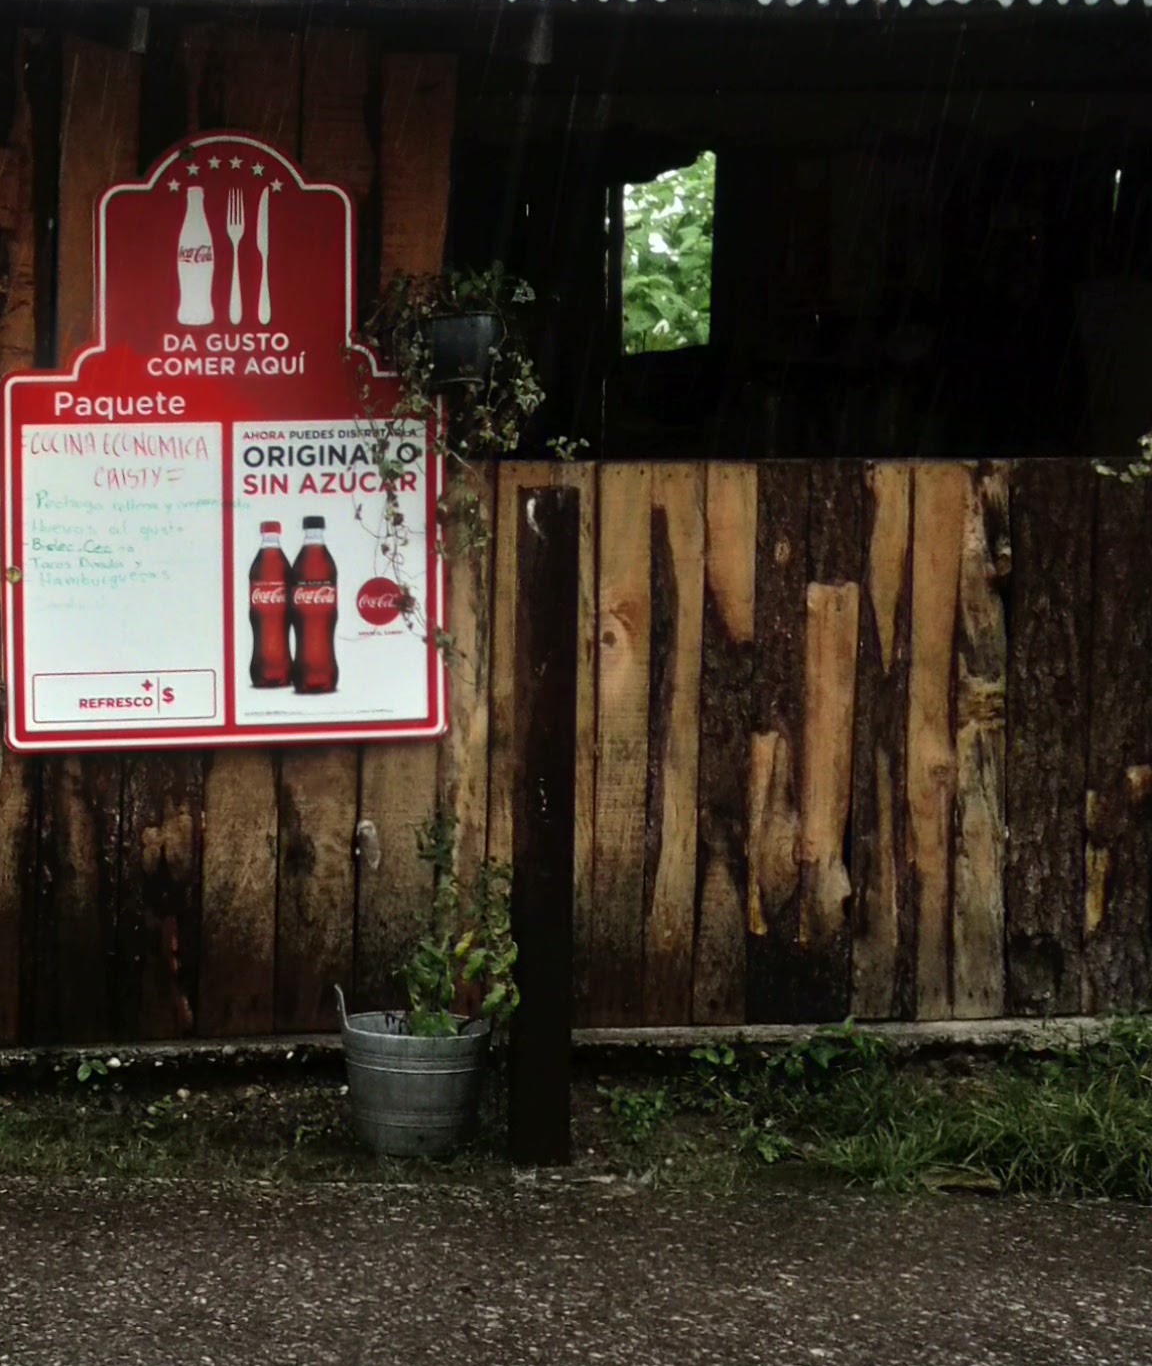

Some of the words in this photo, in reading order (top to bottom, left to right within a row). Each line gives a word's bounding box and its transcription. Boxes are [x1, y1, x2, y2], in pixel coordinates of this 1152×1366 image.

[163, 334, 197, 352] DA
[206, 333, 289, 352] GUSTO
[147, 357, 235, 376] COMER
[244, 351, 306, 375] AQUÍ
[54, 391, 186, 421] Paquete
[243, 430, 285, 440] AHORA
[290, 429, 334, 440] PUEDES
[338, 427, 417, 439] DISFRTARLA
[396, 442, 418, 465] O
[243, 473, 288, 495] SIN
[299, 467, 417, 495] AZÚCAR
[79, 697, 153, 709] REFRESCO
[162, 687, 175, 704] $
